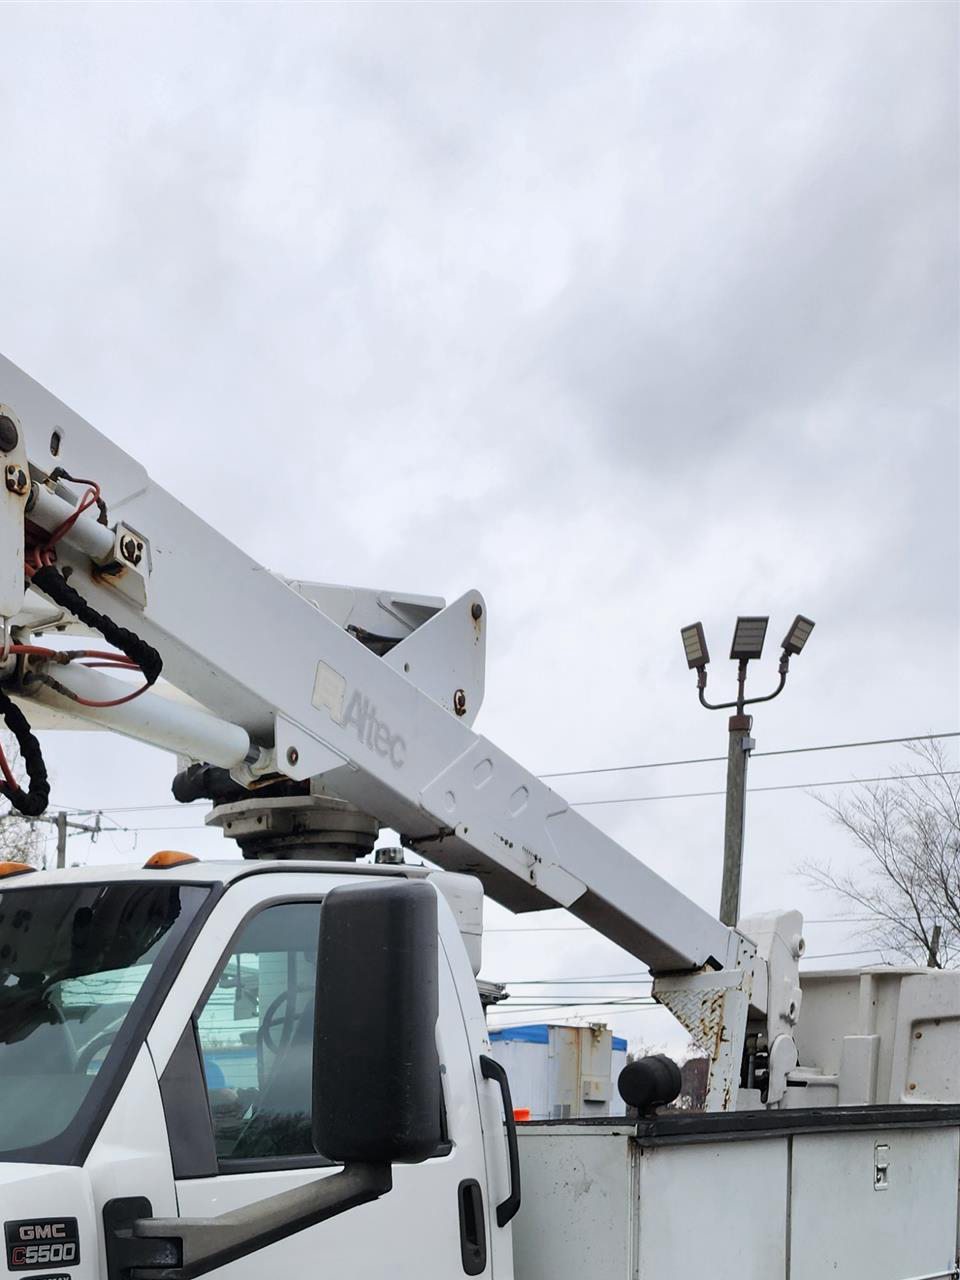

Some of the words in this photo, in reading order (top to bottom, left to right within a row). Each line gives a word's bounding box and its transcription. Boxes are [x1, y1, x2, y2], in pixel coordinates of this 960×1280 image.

[343, 688, 407, 770] Altec
[19, 1223, 66, 1240] GMC
[12, 1243, 76, 1265] C5500
